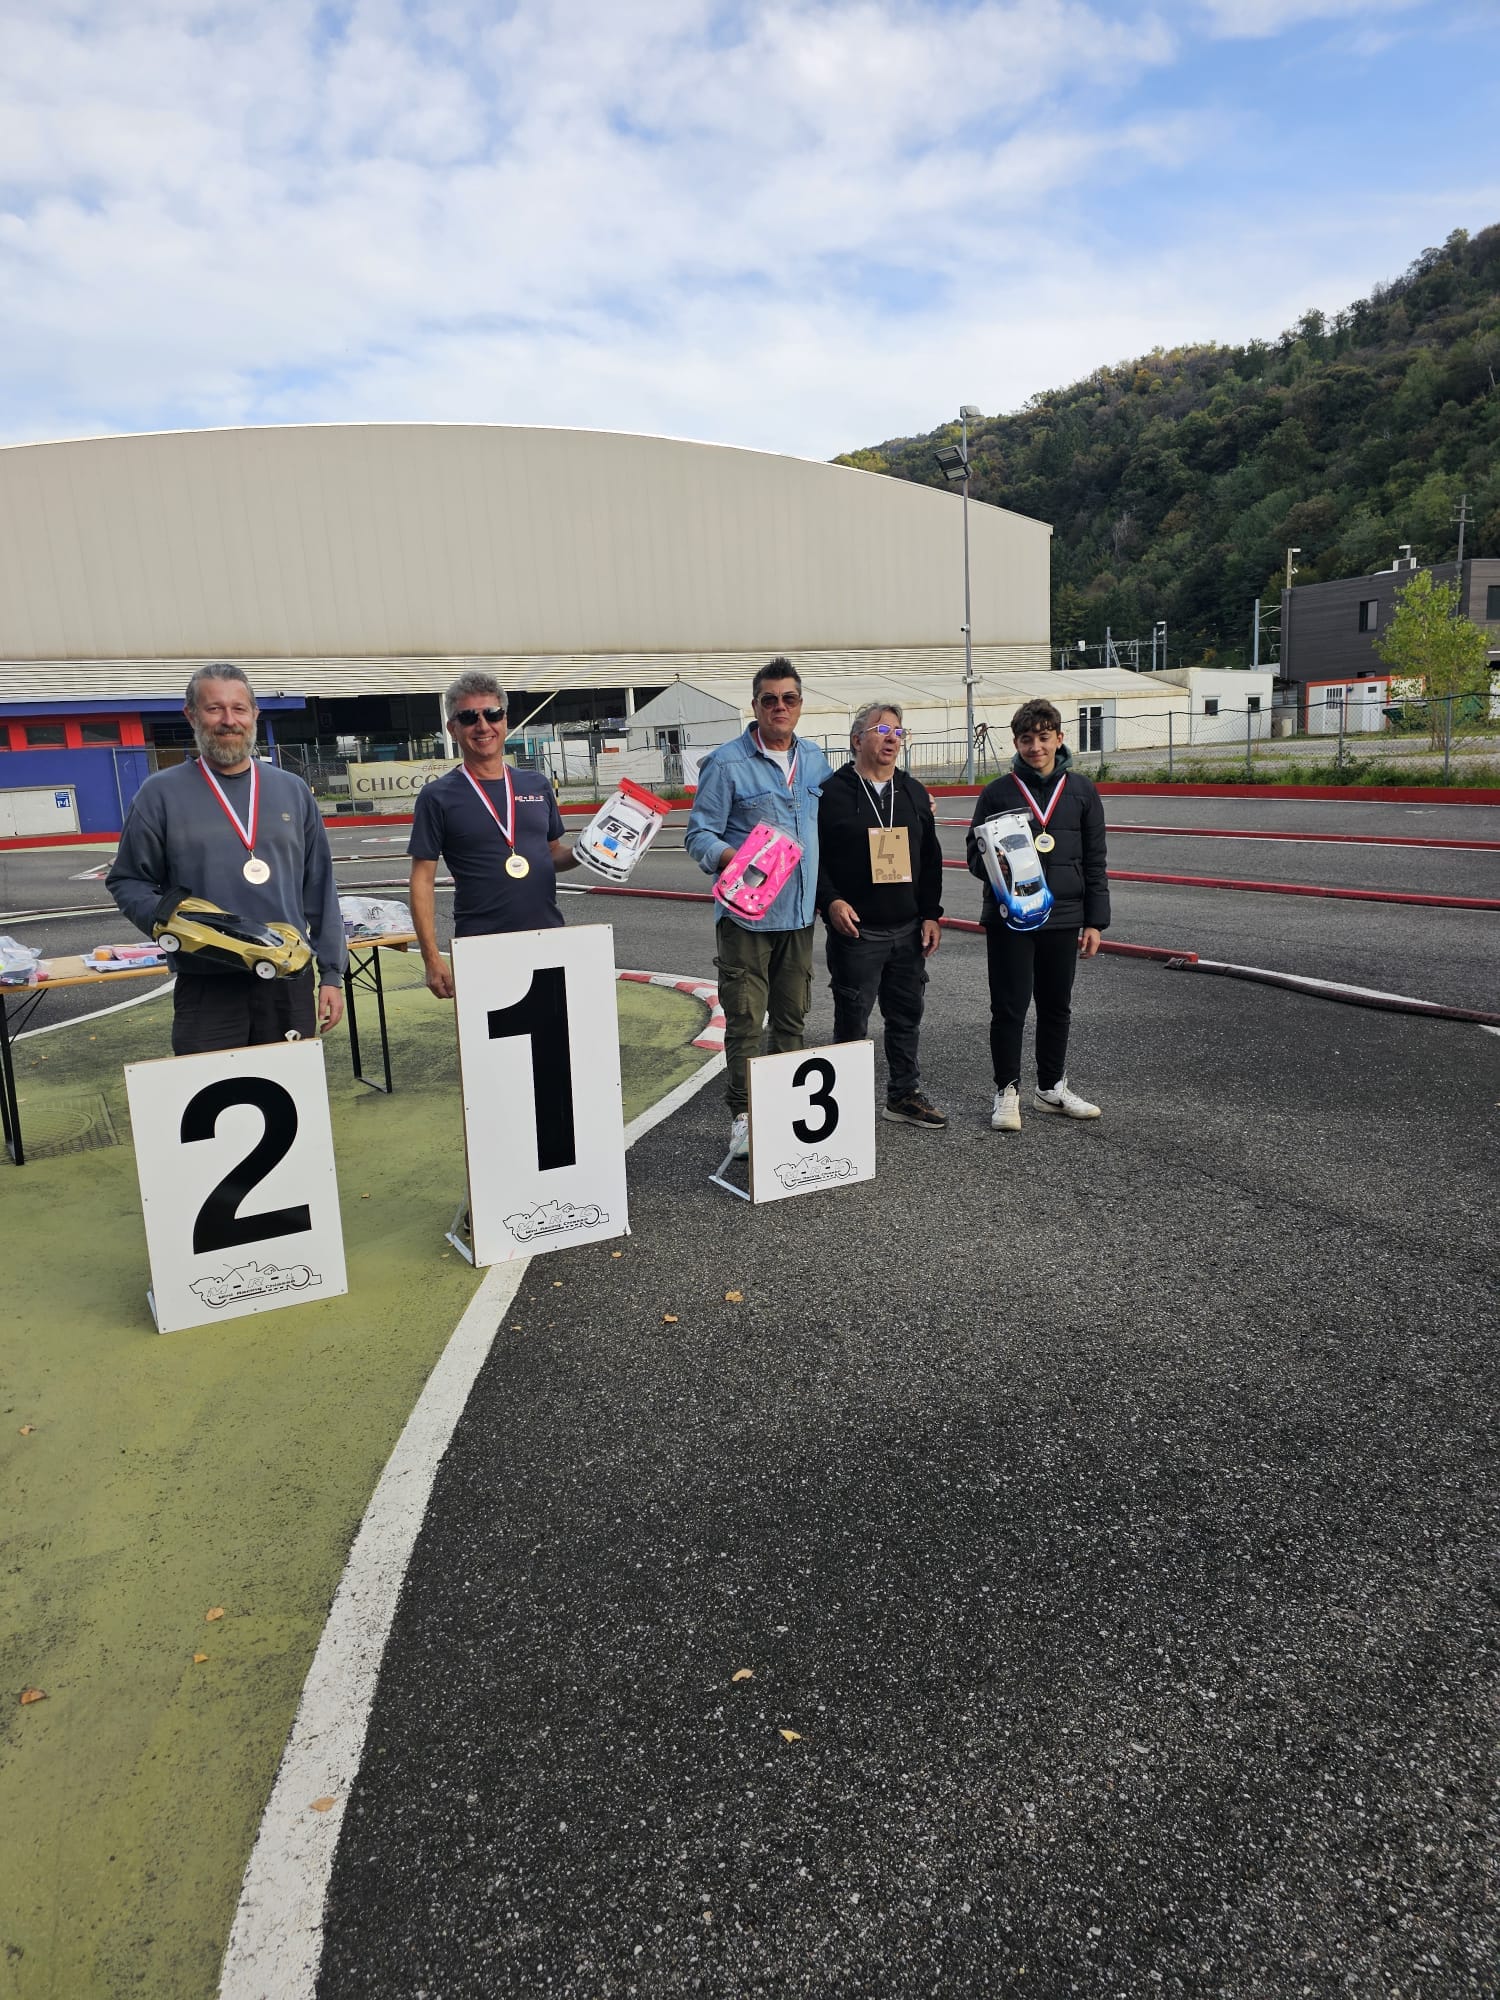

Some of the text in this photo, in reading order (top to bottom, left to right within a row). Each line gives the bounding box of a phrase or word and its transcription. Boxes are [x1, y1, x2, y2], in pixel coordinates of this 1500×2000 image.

[488, 967, 576, 1171] 1
[793, 1058, 838, 1143] 3
[181, 1077, 311, 1254] 2
